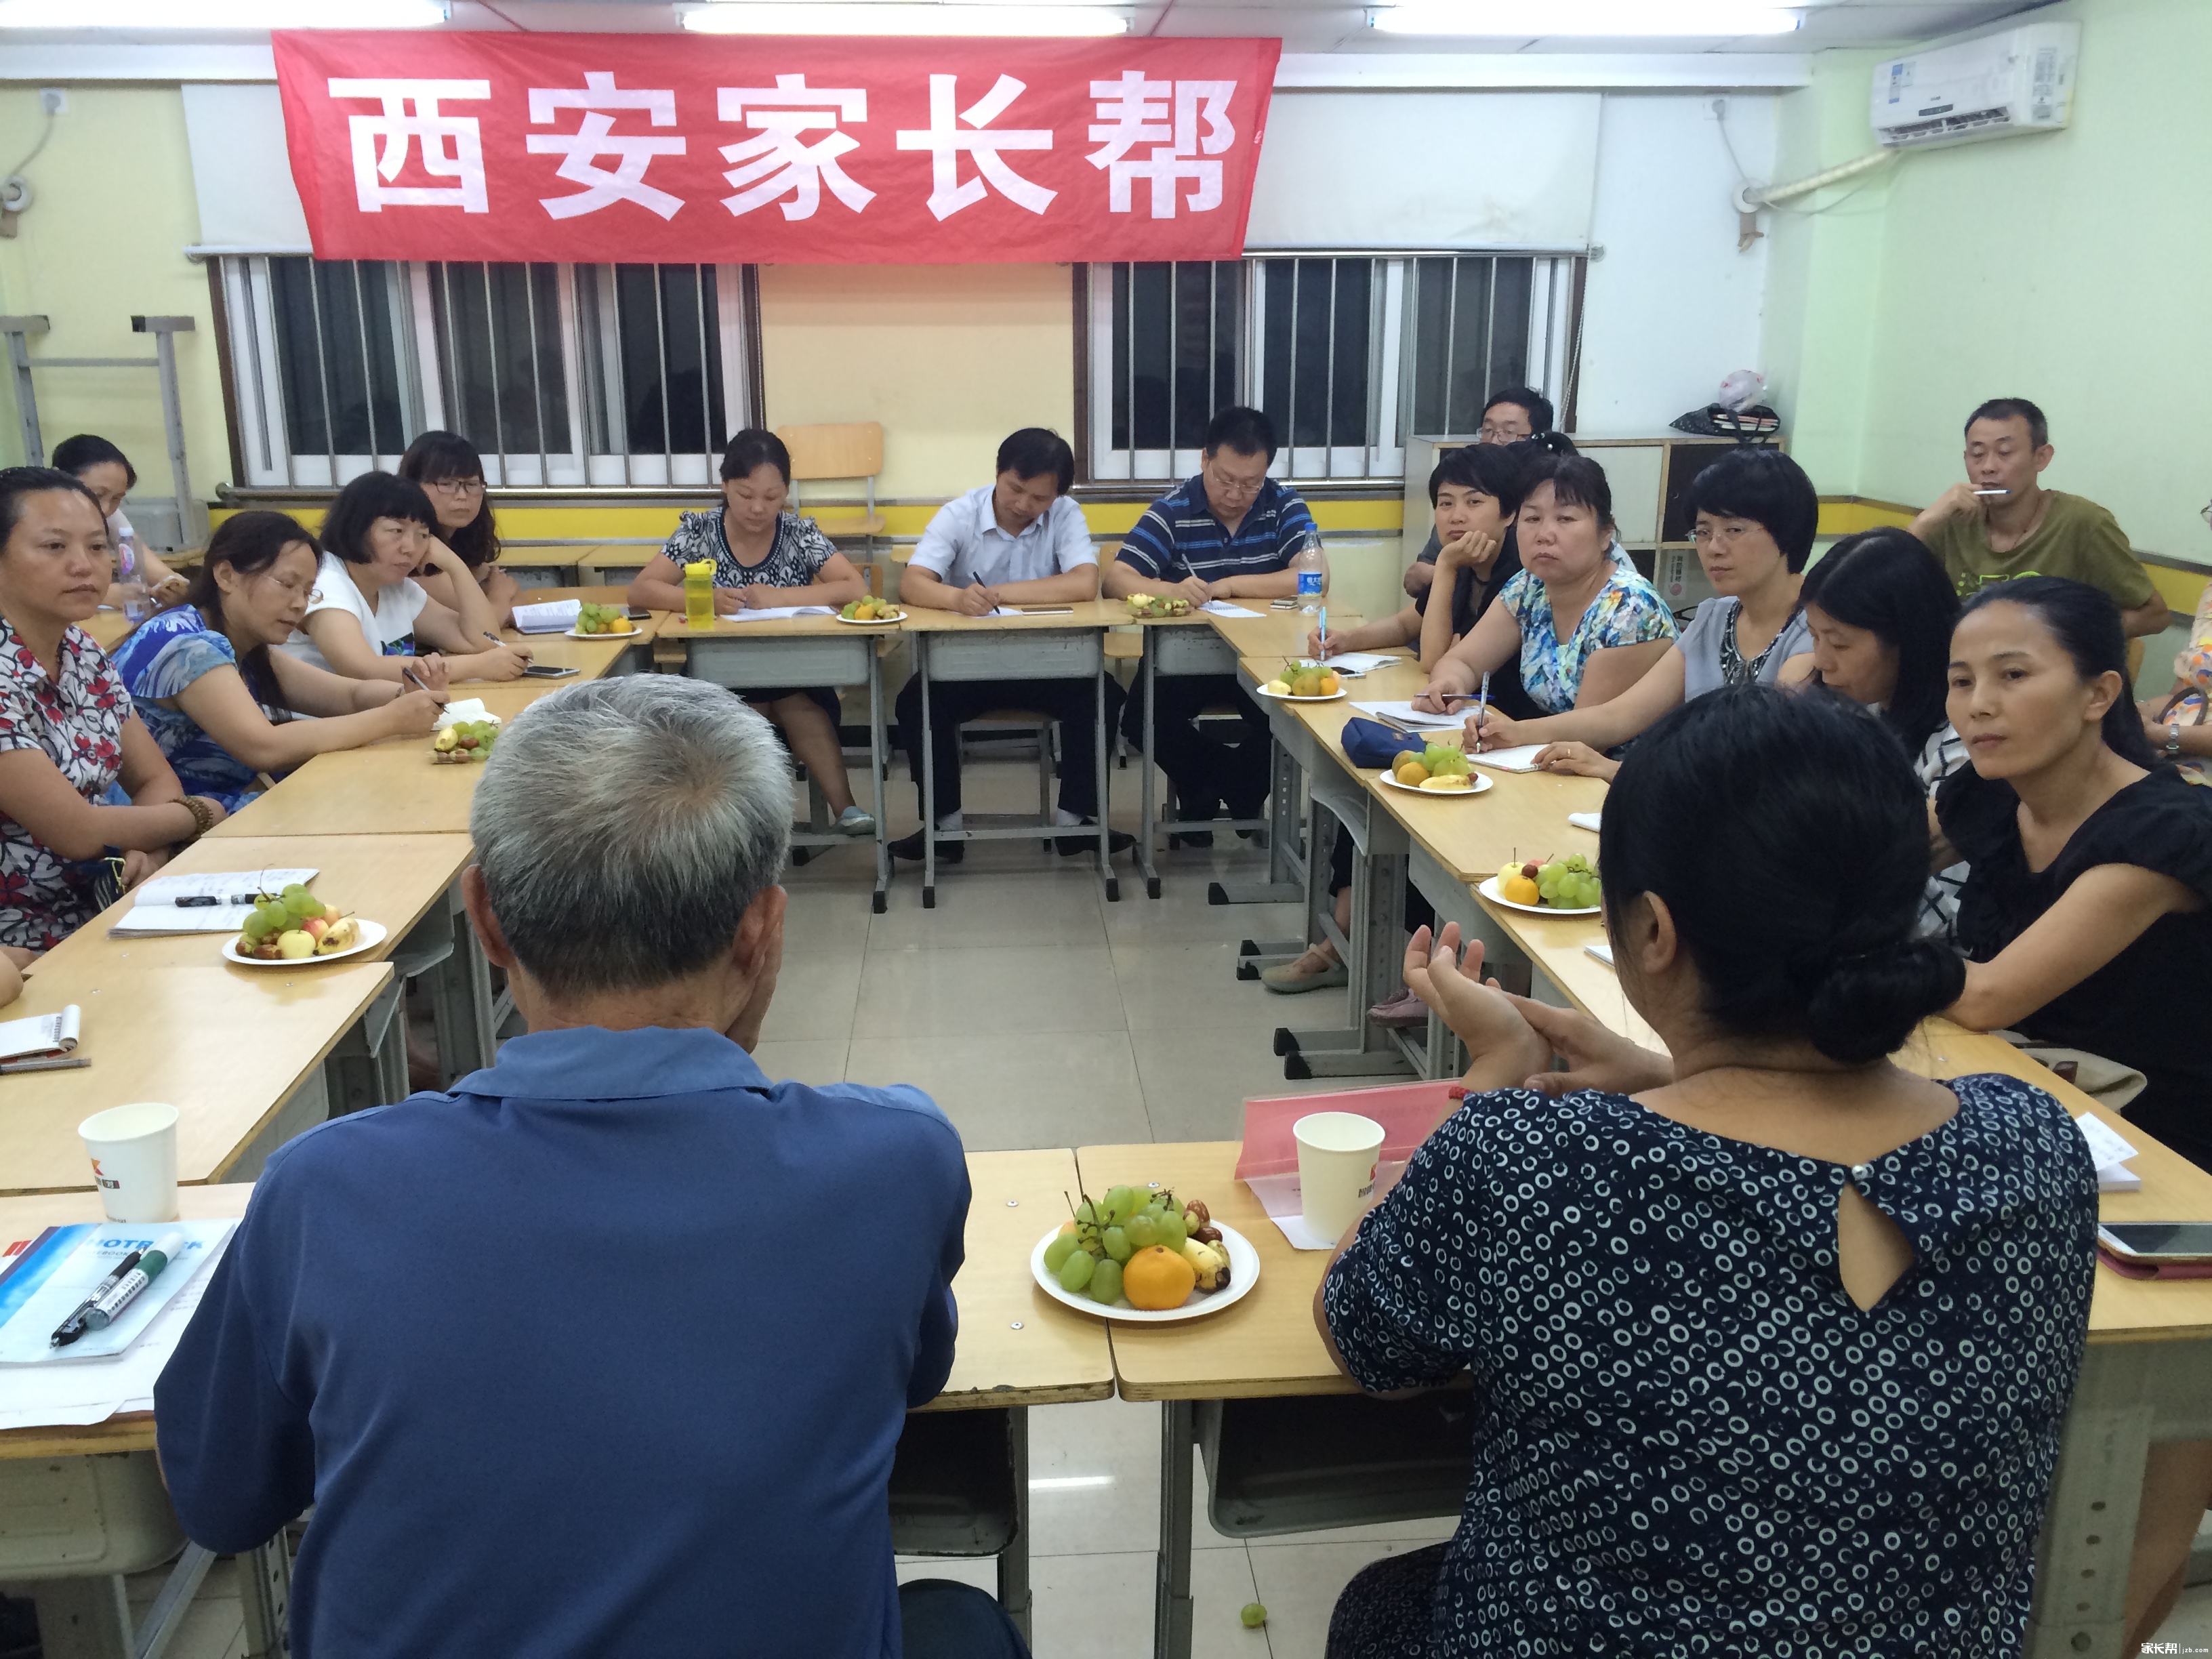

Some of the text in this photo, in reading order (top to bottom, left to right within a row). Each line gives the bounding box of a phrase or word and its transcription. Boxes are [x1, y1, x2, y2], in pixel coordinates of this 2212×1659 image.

[327, 70, 1238, 221] 西安家长帮
